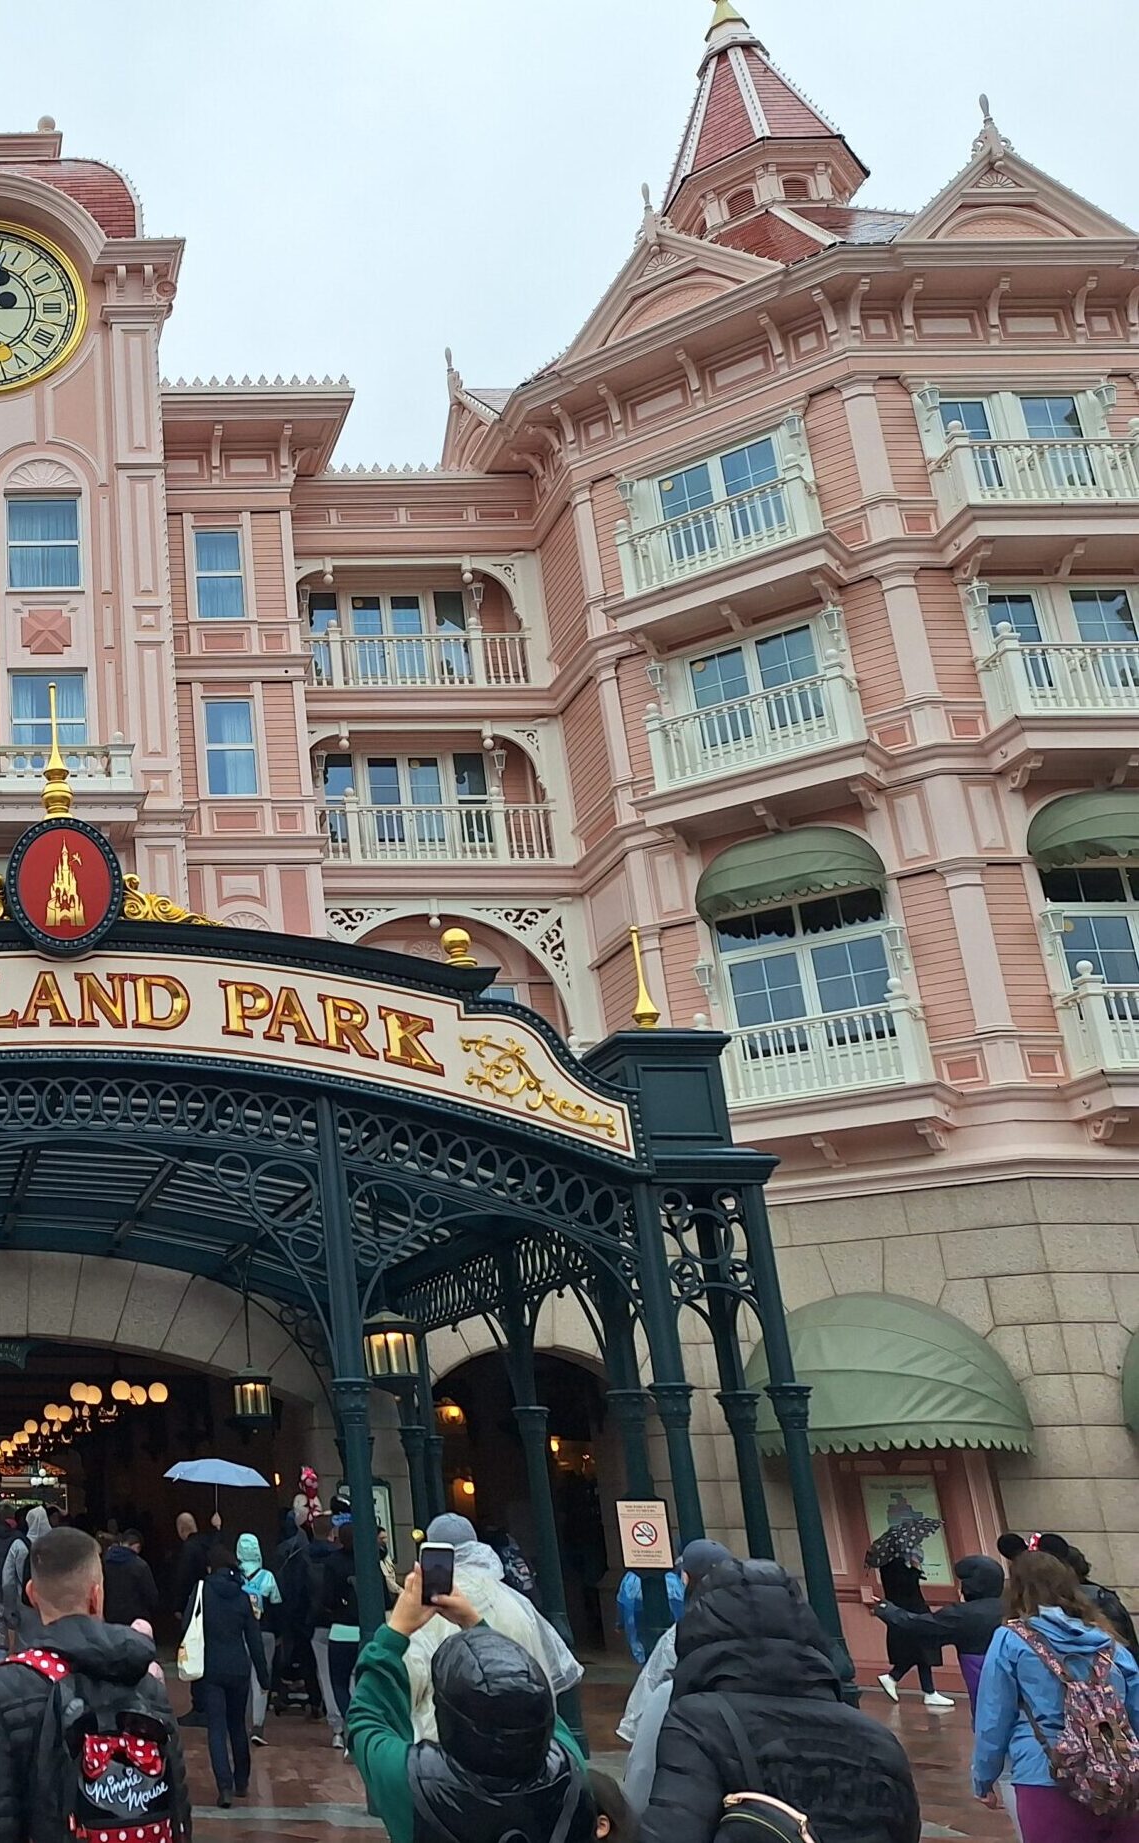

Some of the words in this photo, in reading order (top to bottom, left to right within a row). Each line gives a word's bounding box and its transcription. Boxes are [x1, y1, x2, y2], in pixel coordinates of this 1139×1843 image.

[10, 251, 21, 266] I
[32, 272, 52, 286] II
[42, 302, 62, 314] III
[32, 328, 56, 348] IIII
[13, 353, 28, 369] V
[218, 979, 446, 1077] PARK
[85, 1767, 143, 1804] Minnie
[117, 1781, 169, 1812] Mouse
